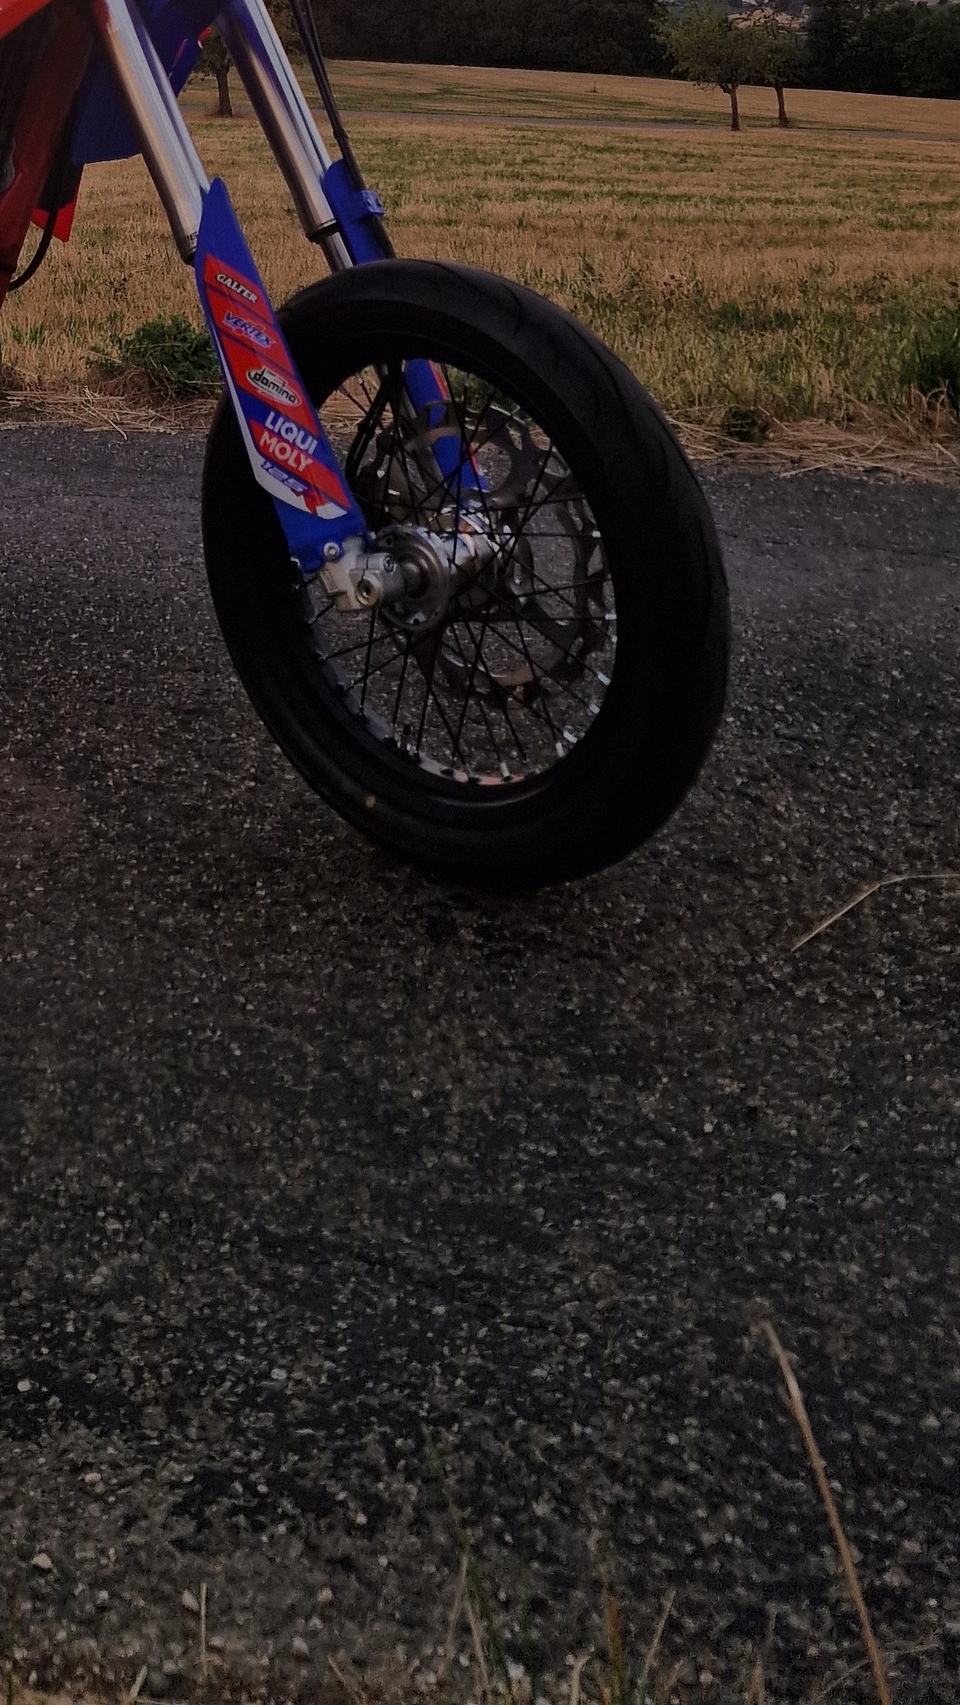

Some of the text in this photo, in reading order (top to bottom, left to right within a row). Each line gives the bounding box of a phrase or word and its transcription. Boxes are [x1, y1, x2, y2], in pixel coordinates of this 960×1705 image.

[216, 272, 258, 303] GALFER
[224, 311, 273, 348] VERTEX
[253, 367, 297, 403] domino
[265, 411, 318, 455] LIQUI
[259, 431, 314, 473] MOLY
